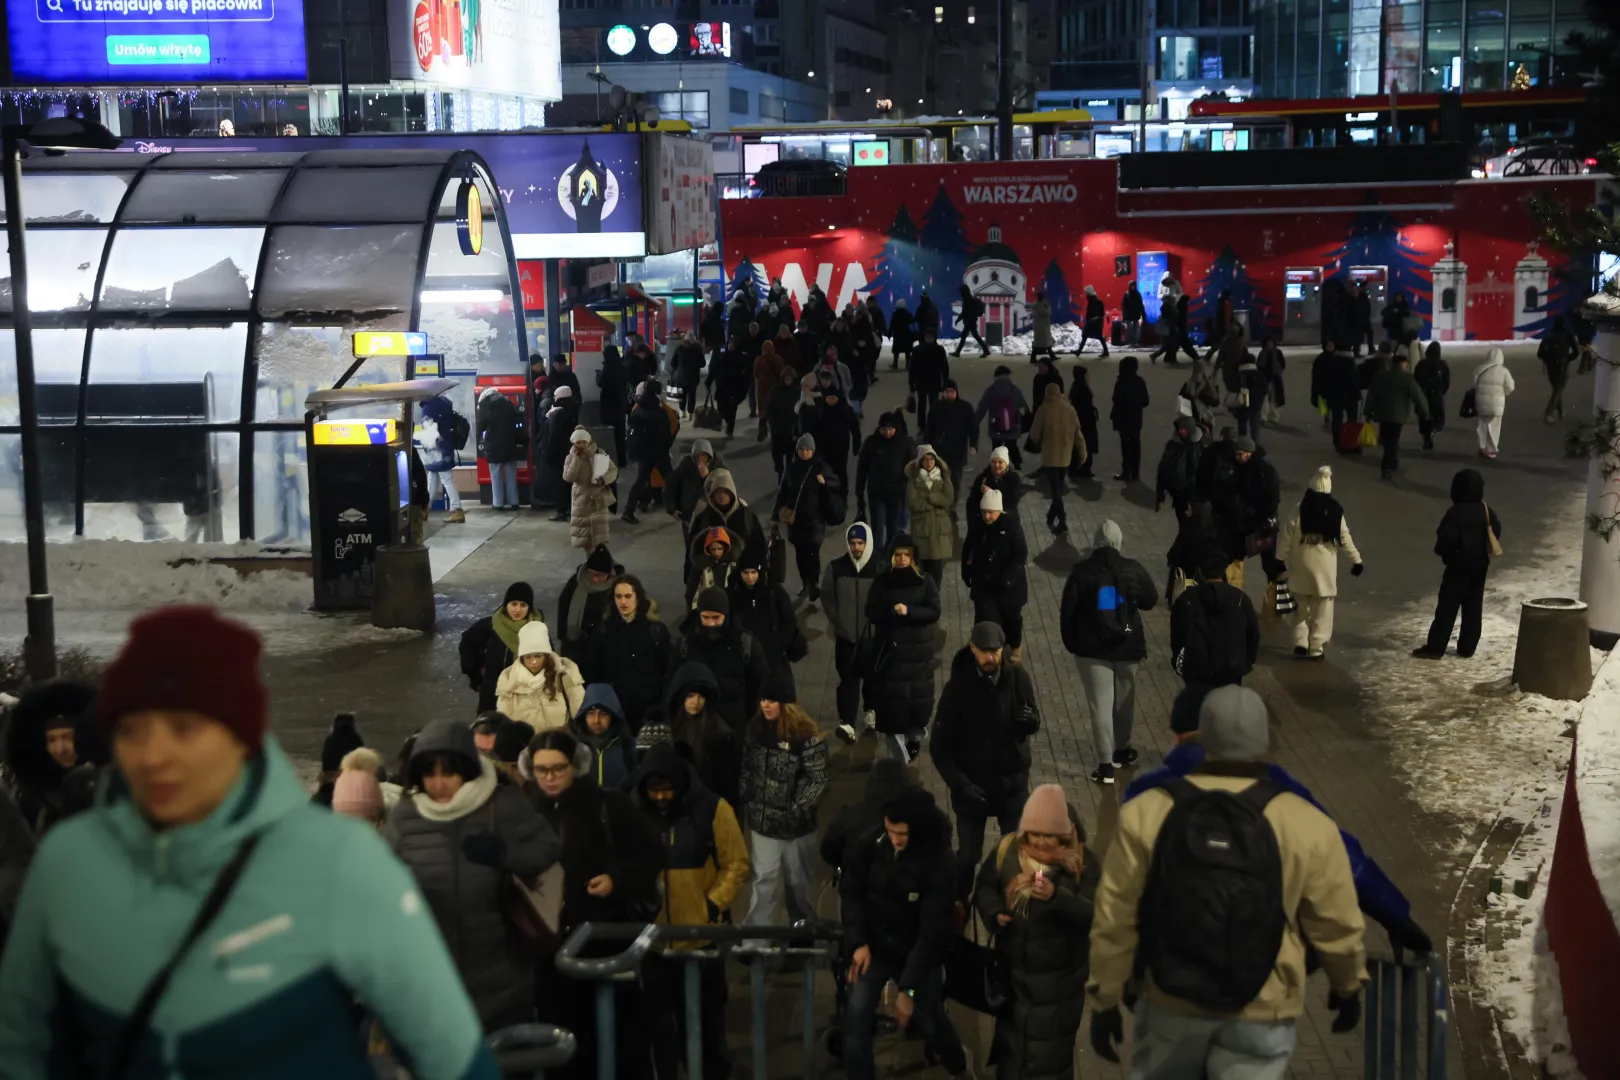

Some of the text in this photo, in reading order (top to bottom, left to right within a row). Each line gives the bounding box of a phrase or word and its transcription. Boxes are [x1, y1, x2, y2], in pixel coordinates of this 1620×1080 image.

[73, 0, 93, 11] Tu
[95, 0, 163, 15] znajduje
[114, 43, 202, 59] Umów wizytę
[963, 184, 1078, 204] WARSZAWO
[346, 533, 372, 544] ATM
